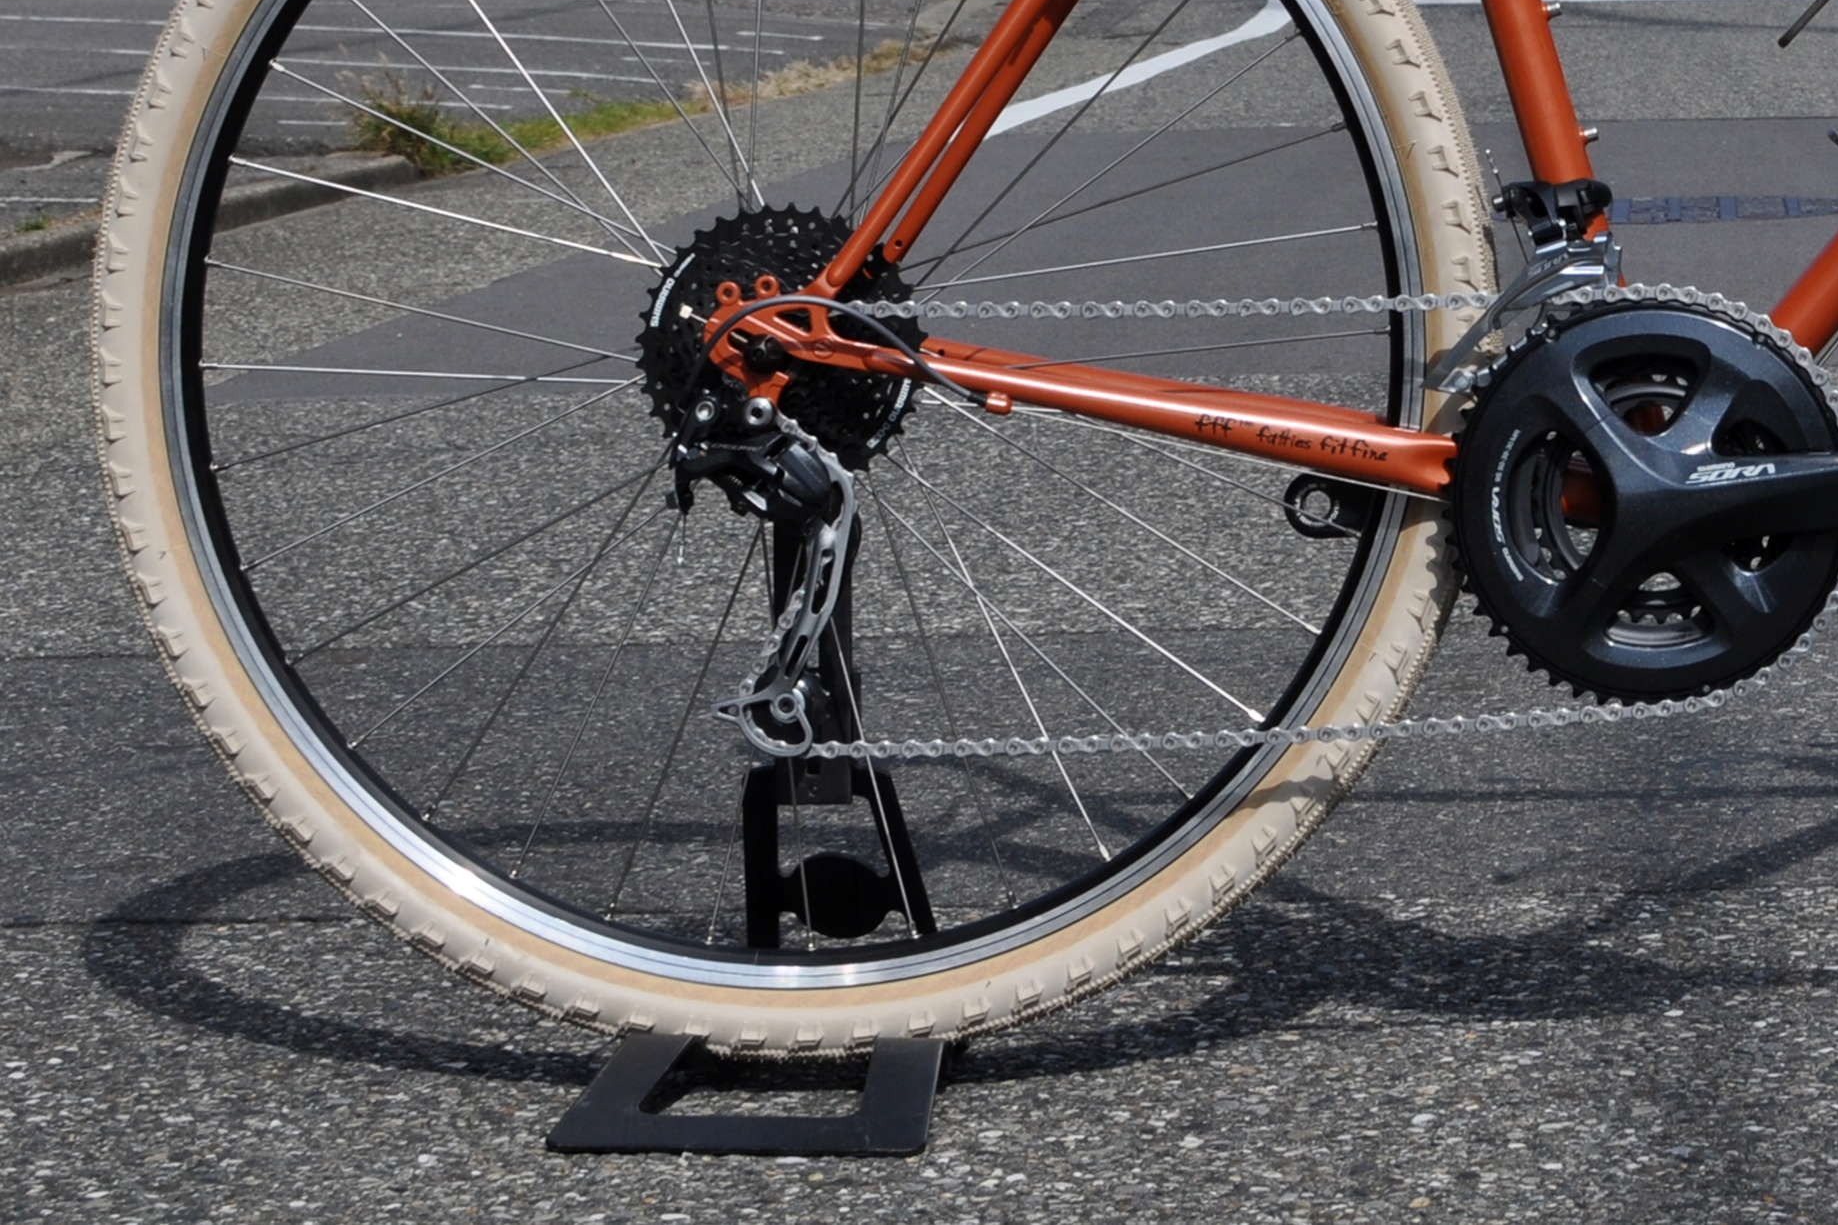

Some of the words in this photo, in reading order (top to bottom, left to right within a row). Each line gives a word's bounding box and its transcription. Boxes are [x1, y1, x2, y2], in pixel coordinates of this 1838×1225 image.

[649, 277, 676, 327] SHIMANO
[1350, 439, 1389, 461] fine
[1685, 463, 1776, 485] SORA
